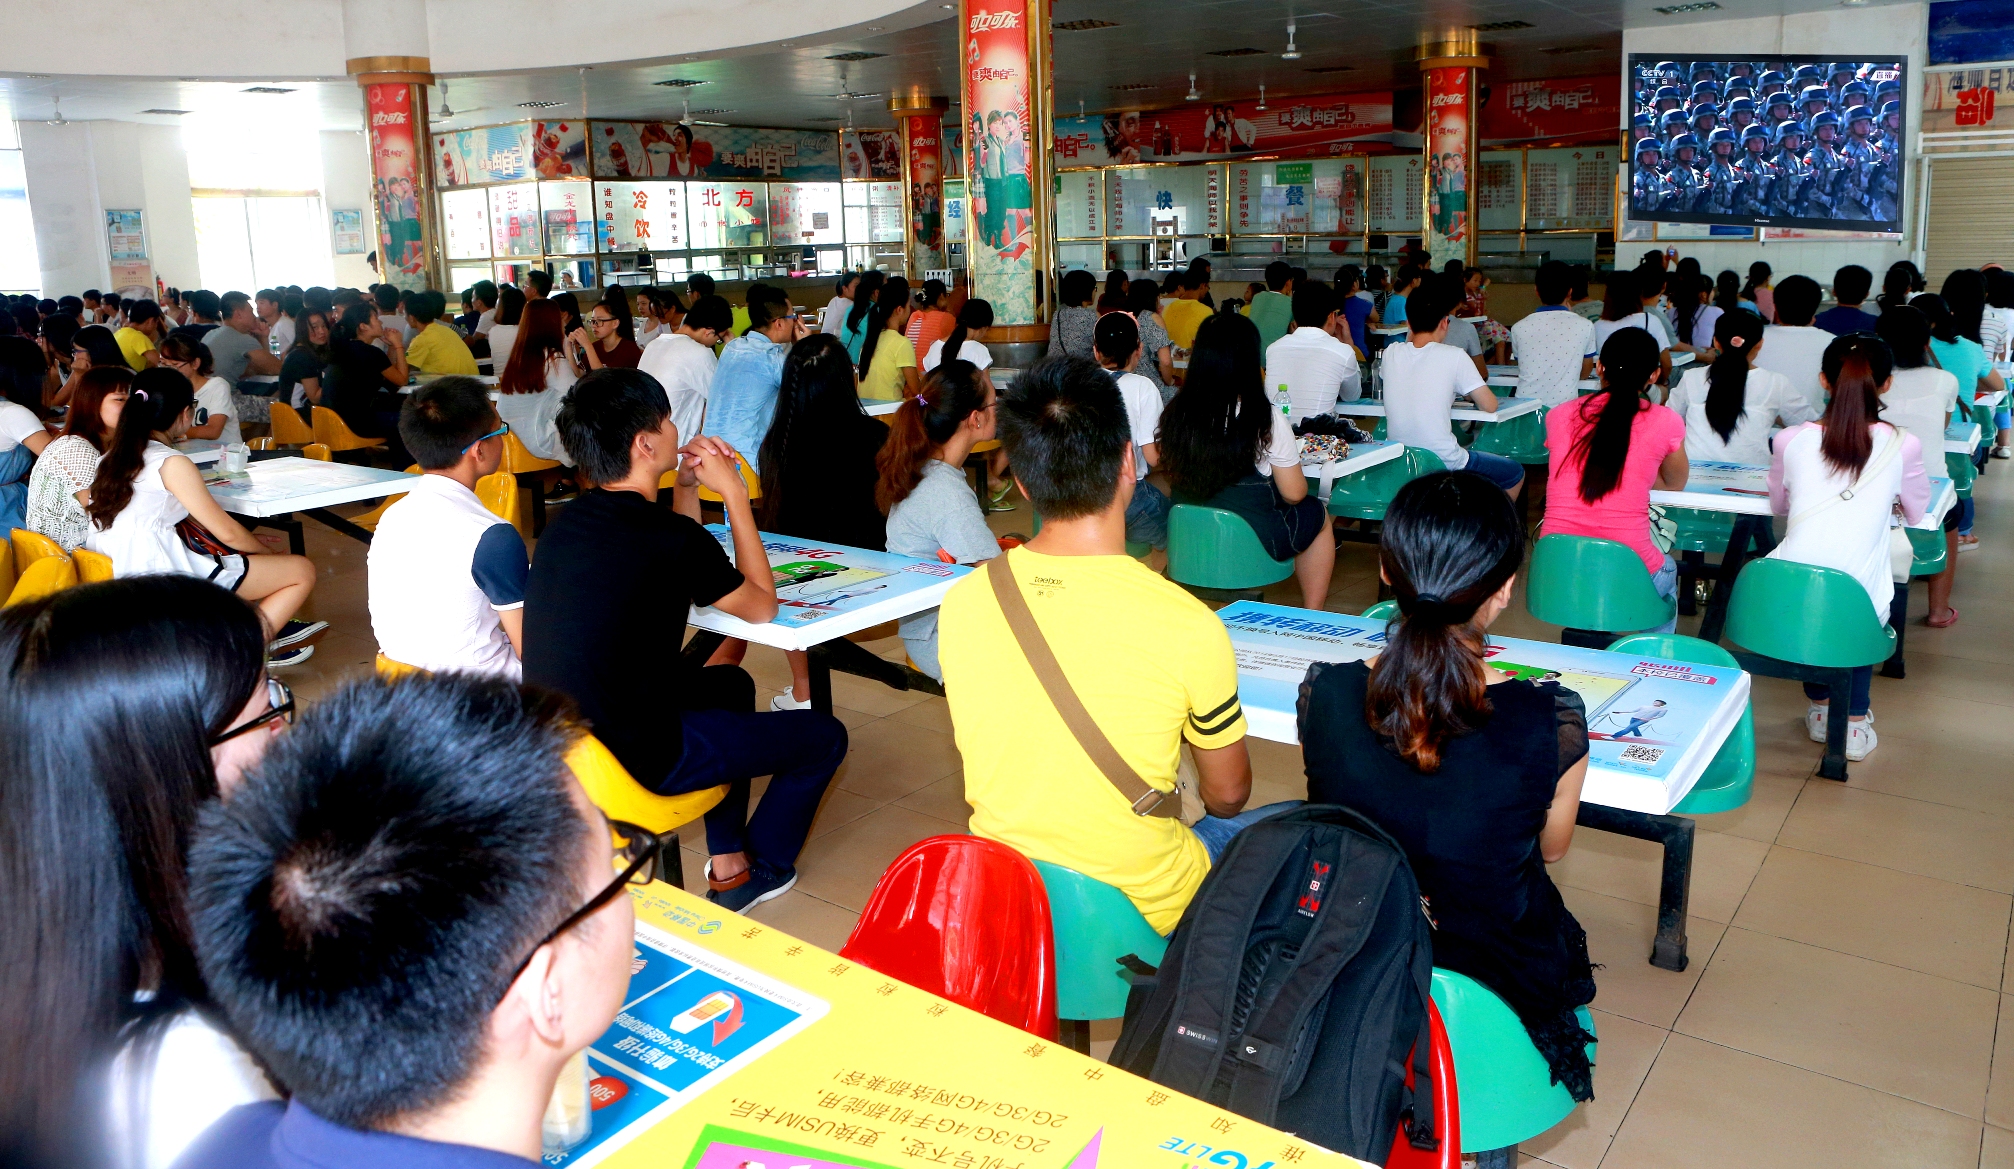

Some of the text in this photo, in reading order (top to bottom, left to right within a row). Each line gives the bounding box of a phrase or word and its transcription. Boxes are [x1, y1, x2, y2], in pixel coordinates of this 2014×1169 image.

[970, 9, 1022, 33] 可口可乐
[1432, 93, 1466, 107] 可口可乐
[372, 111, 408, 126] 可口可乐
[702, 189, 754, 207] 北方
[1156, 190, 1173, 210] 快
[1285, 185, 1304, 206] 餐
[632, 190, 650, 238] 冷饮
[948, 201, 961, 218] 经
[663, 910, 697, 928] 中国移动
[613, 1035, 678, 1071] 体验升级
